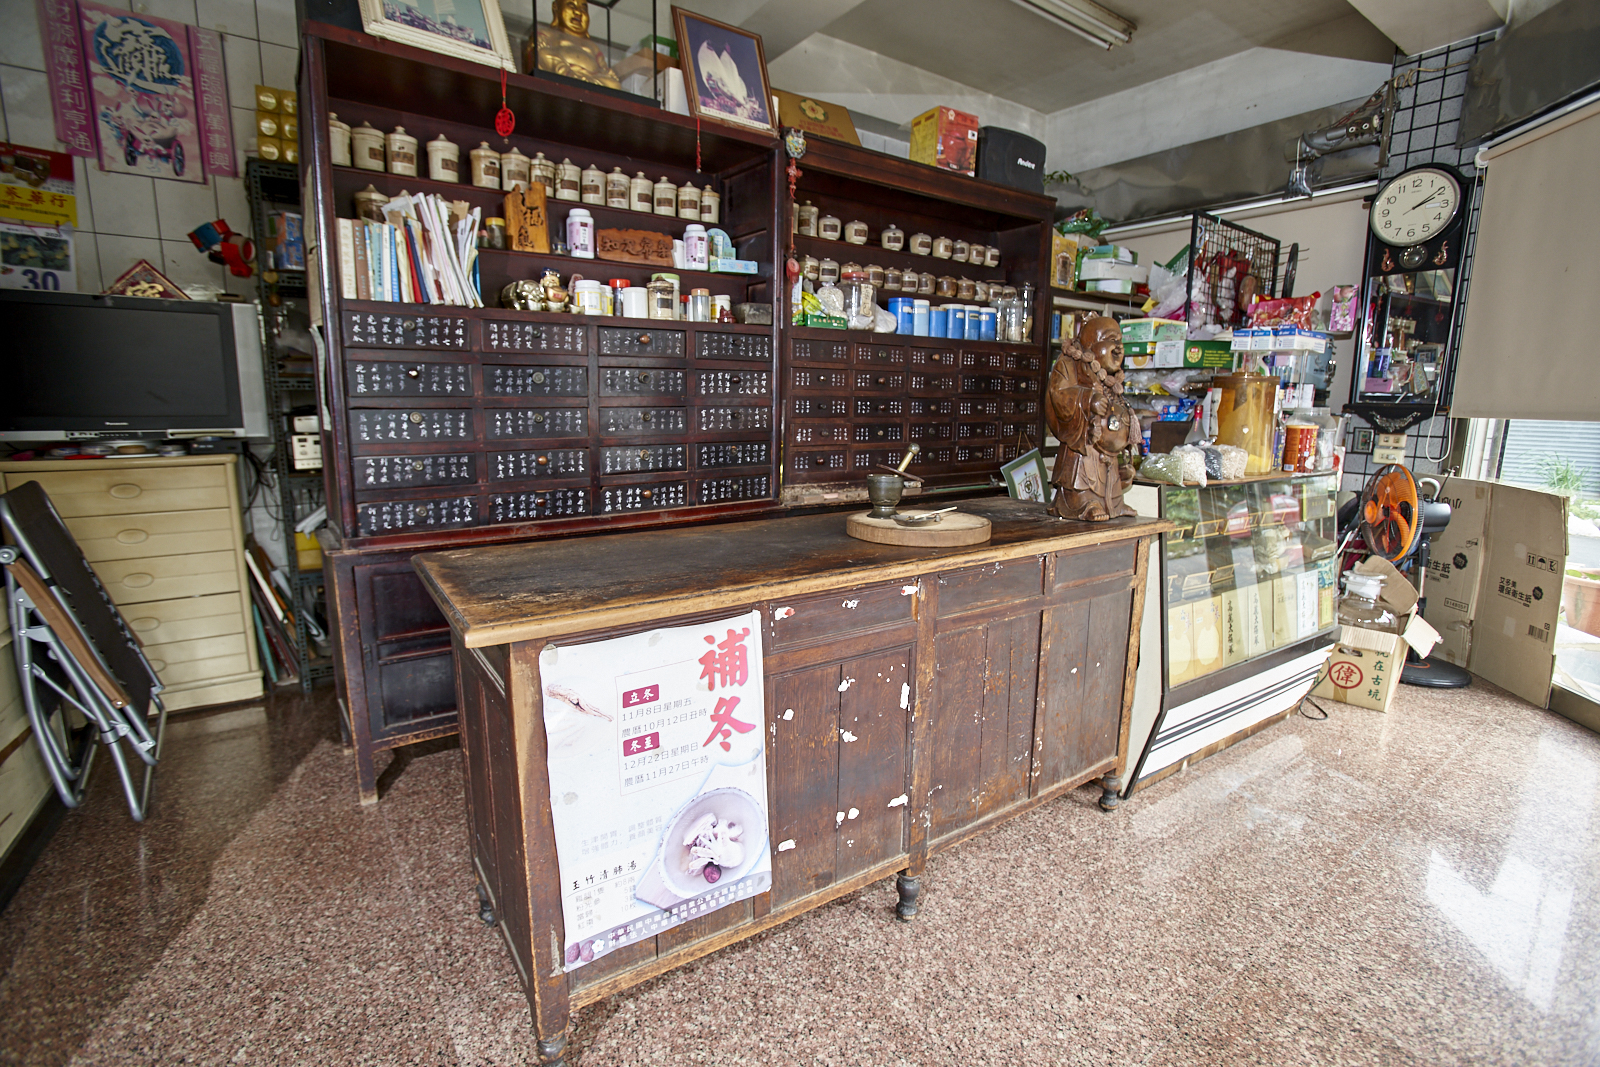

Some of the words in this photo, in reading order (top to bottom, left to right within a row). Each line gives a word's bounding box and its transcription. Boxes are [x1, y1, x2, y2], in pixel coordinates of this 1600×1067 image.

[1412, 179, 1423, 188] 12
[1431, 180, 1434, 188] 1
[1398, 185, 1406, 193] 11
[1387, 196, 1397, 205] 10
[1441, 200, 1449, 208] 3
[1382, 209, 1390, 217] 9
[1434, 212, 1441, 221] 4
[1384, 220, 1391, 228] 8
[1422, 223, 1430, 232] 5
[1395, 228, 1402, 236] 7
[1407, 228, 1415, 237] 6
[22, 268, 60, 291] 30
[1333, 665, 1357, 685] 偉
[698, 626, 756, 753] 補冬
[629, 688, 655, 704] 立冬
[621, 697, 693, 722] 11月8日星期五
[629, 735, 654, 753] 冬至
[623, 741, 699, 771] 12月22日星期日
